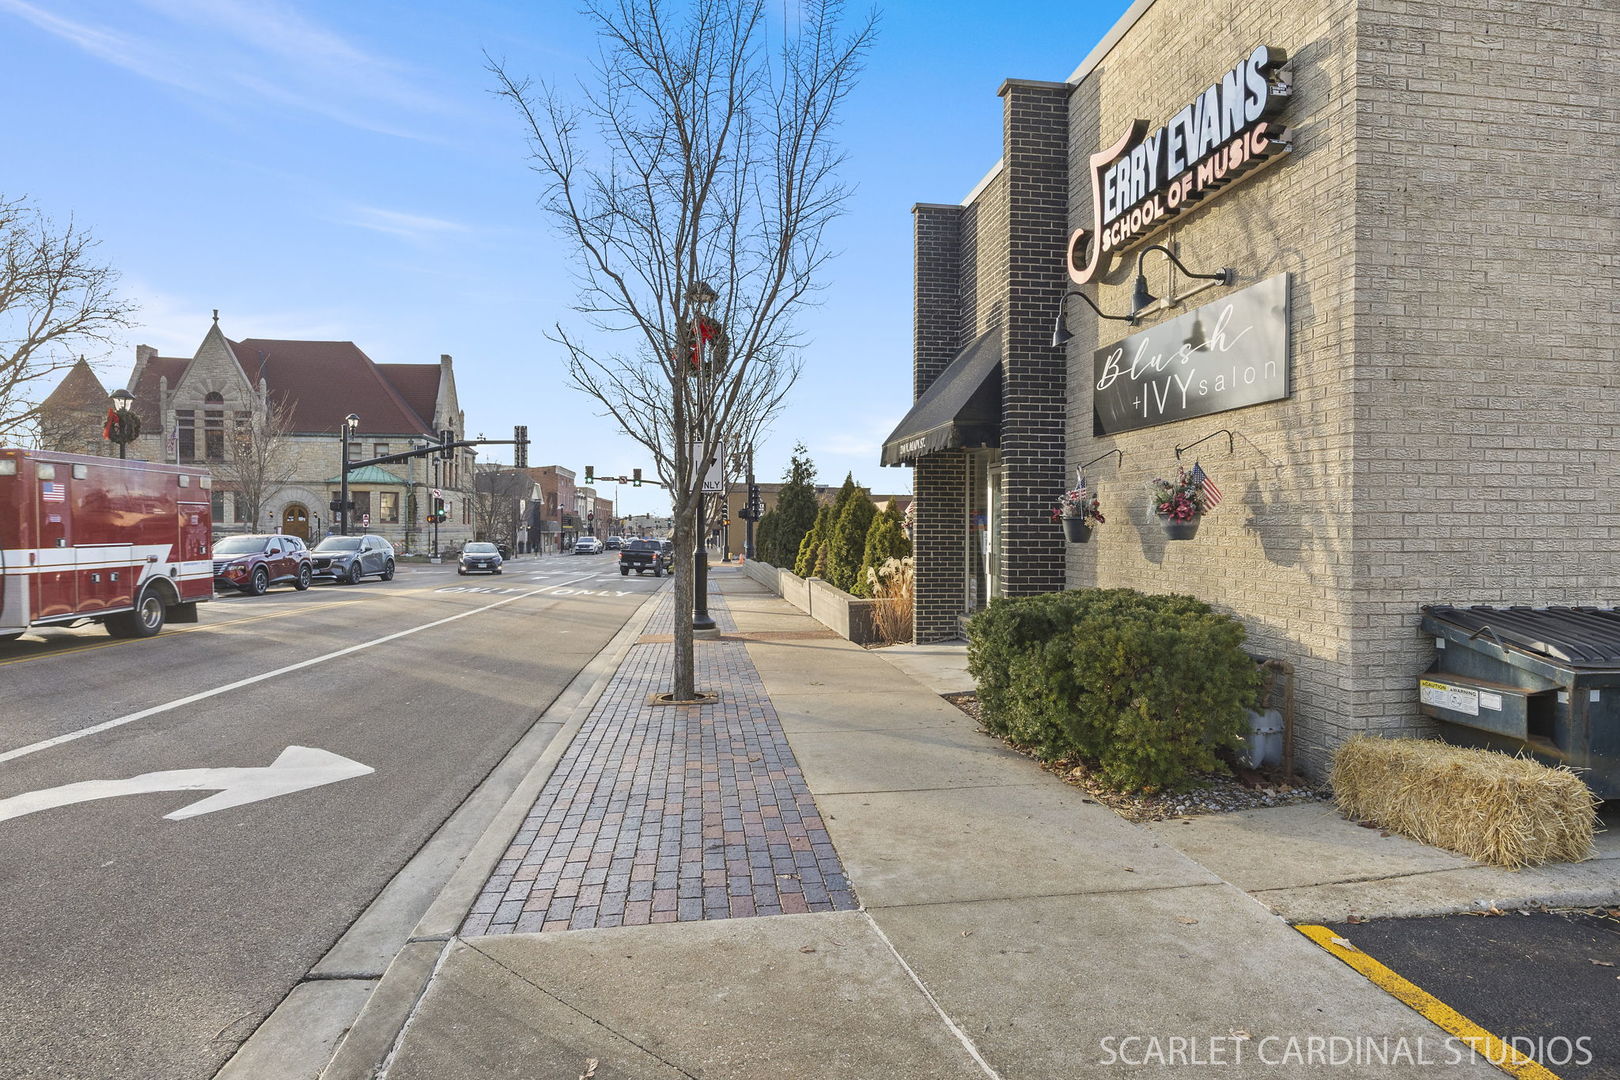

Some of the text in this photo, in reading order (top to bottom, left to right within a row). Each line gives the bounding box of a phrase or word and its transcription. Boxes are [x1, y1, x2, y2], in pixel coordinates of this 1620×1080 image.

[1067, 45, 1269, 285] JERRY EVANS
[1101, 121, 1271, 253] SCHOOL OF MUSIC
[1096, 303, 1254, 391] Blush
[551, 589, 633, 597] ONLY
[1425, 682, 1446, 690] CAUTION
[1452, 687, 1477, 697] WARNING
